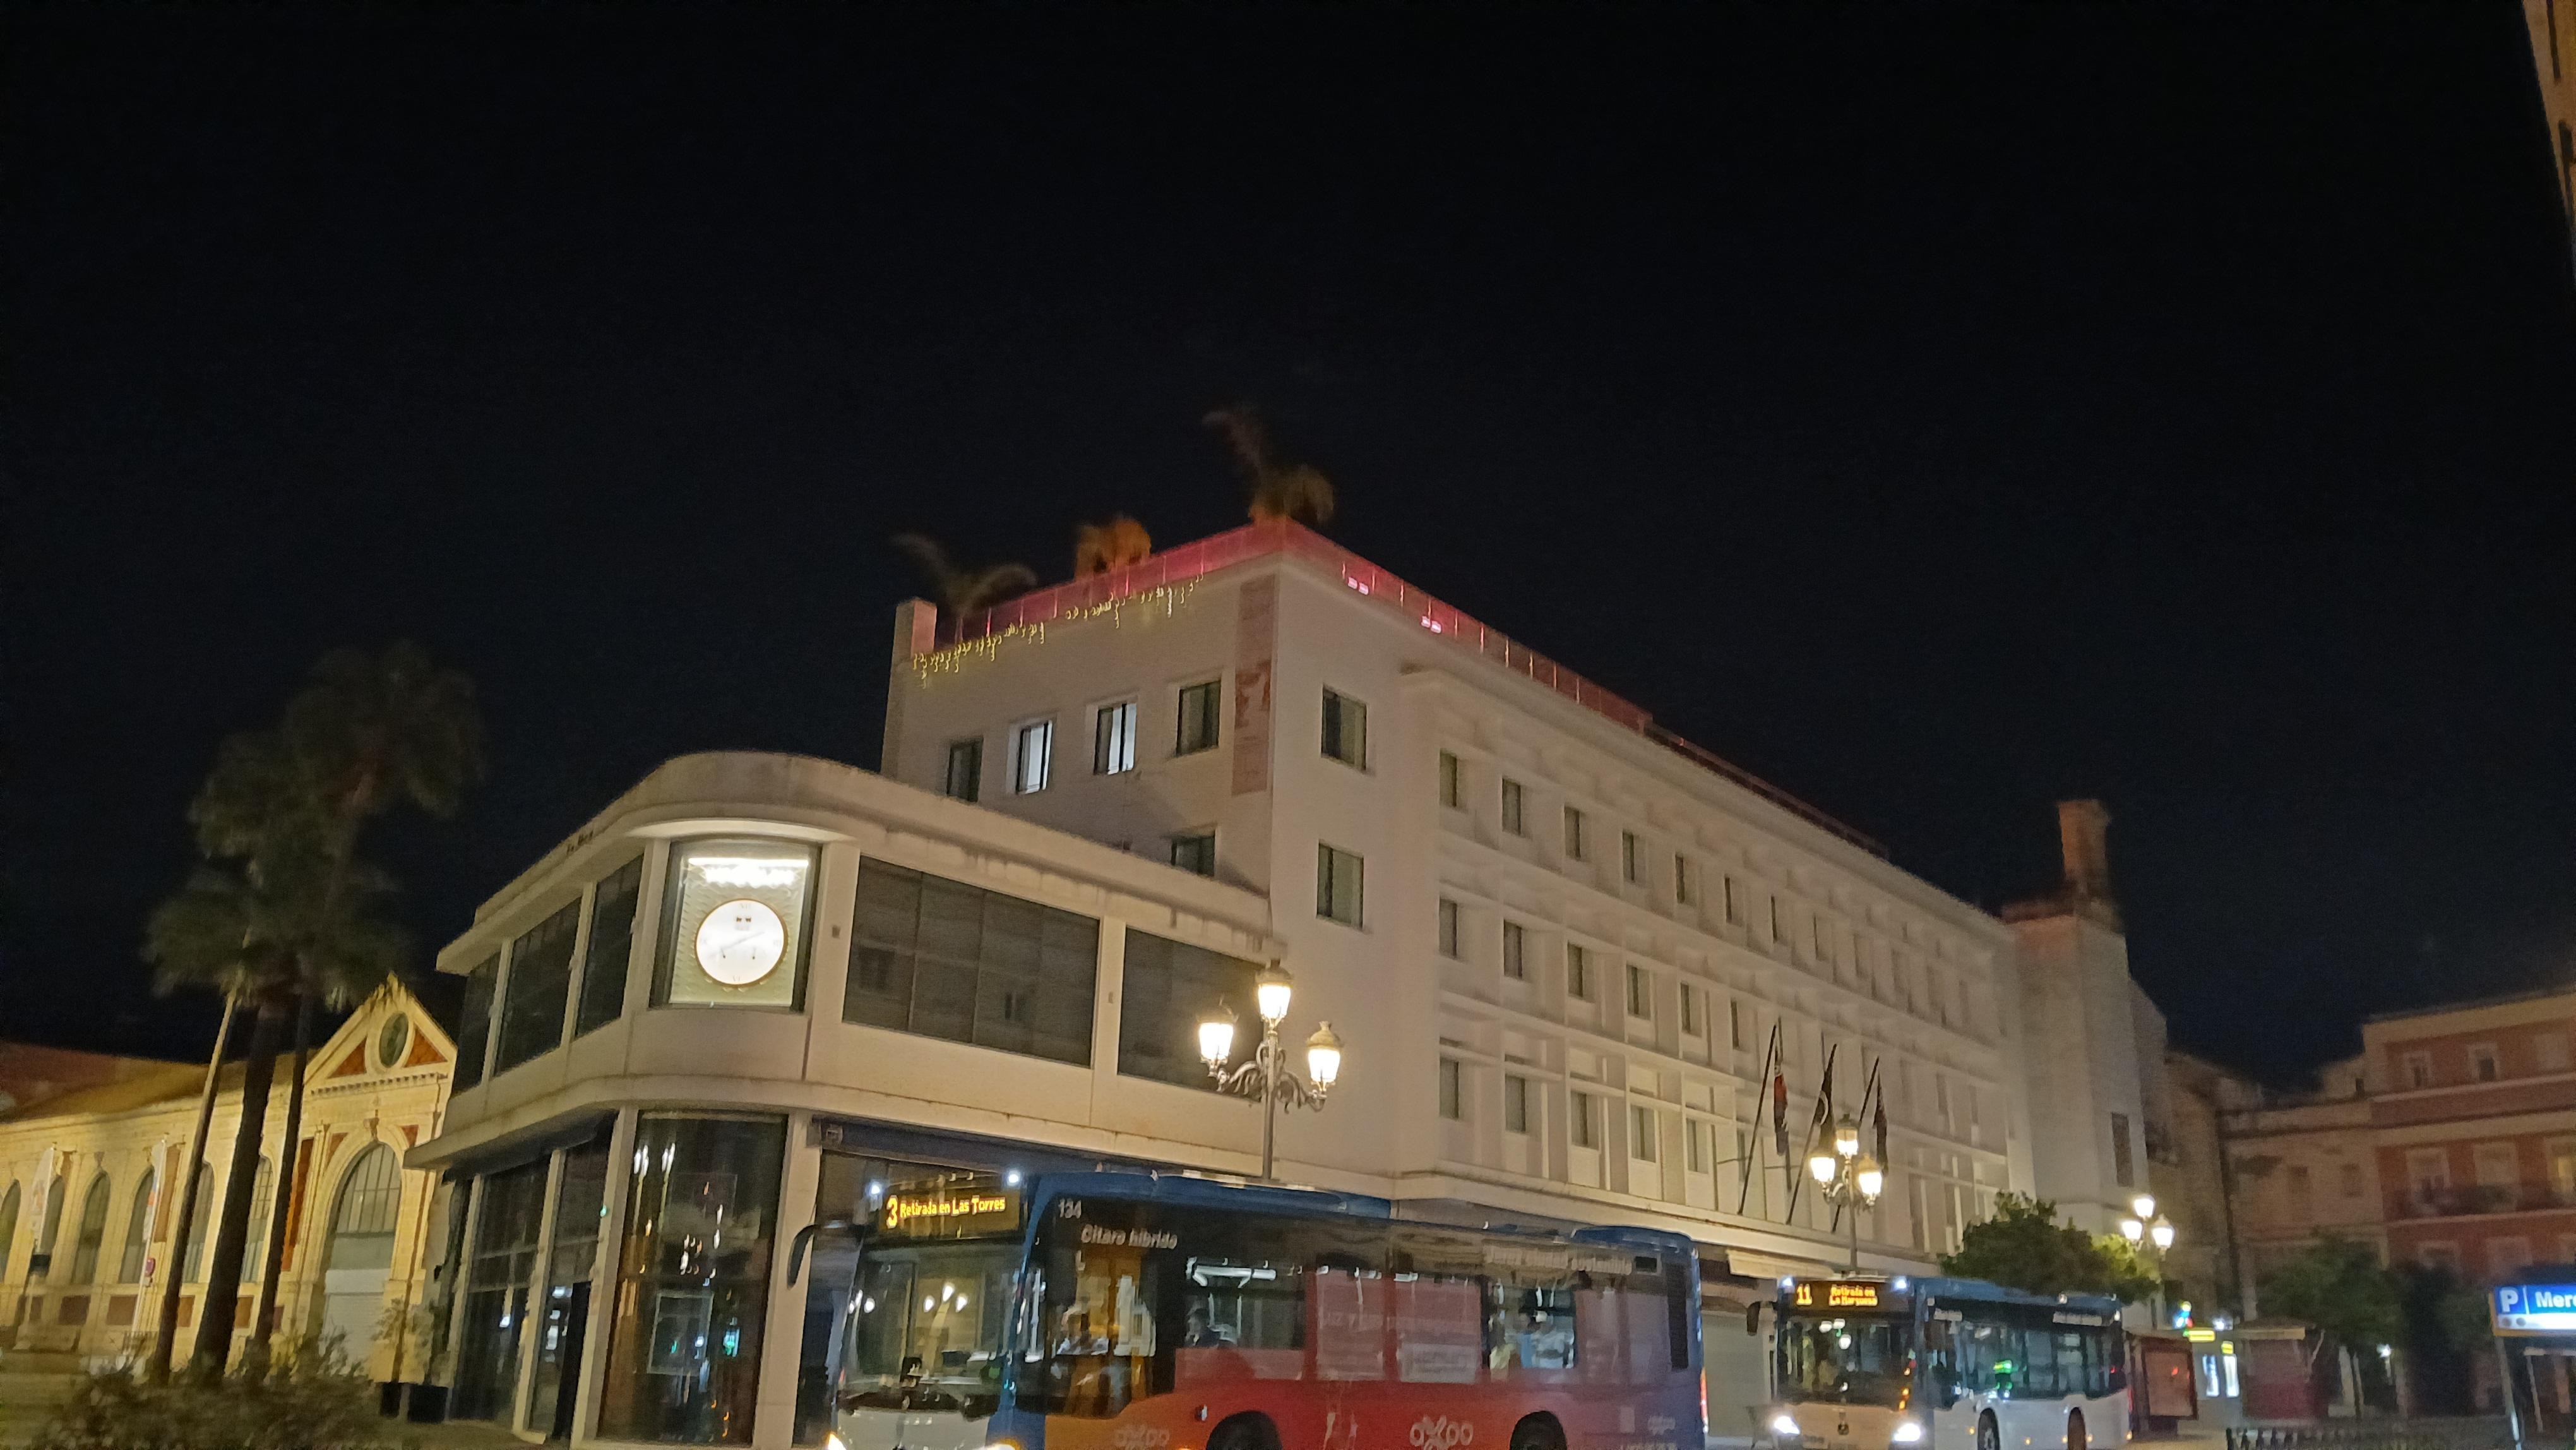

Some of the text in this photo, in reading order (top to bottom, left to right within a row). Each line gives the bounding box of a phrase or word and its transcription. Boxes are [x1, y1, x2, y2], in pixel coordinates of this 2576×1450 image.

[886, 1195, 1006, 1228] 3 Retirada en Las Torres
[1796, 1284, 1812, 1305] 11
[2500, 1287, 2519, 1312] P
